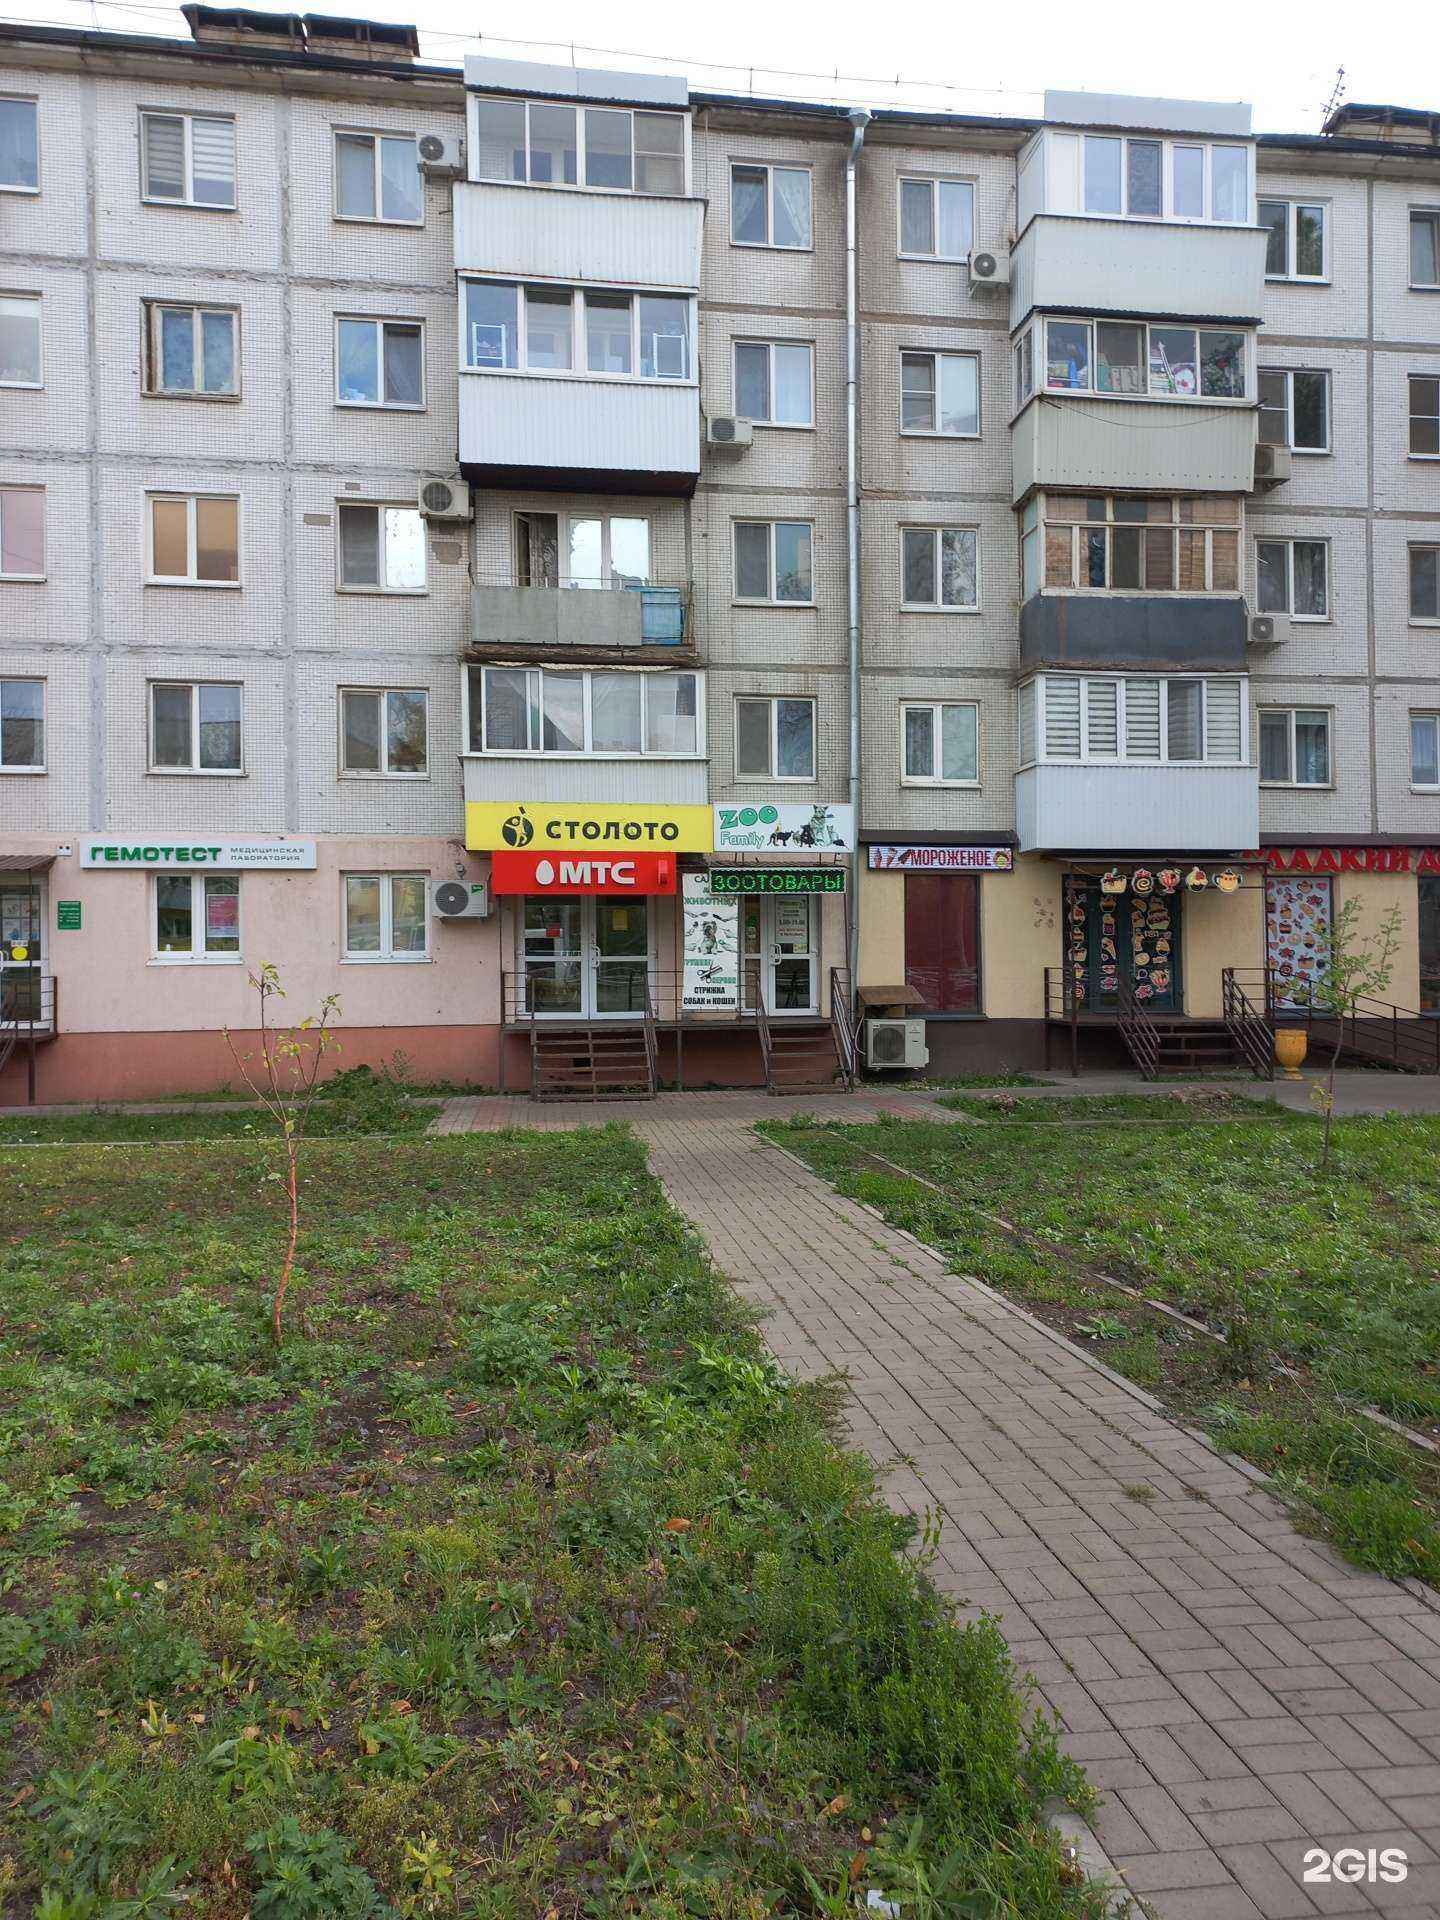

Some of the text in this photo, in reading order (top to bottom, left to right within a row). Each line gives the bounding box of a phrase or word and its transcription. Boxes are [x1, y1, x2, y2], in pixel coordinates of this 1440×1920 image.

[719, 805, 778, 830] ZOO
[546, 820, 679, 840] СТОЛОТО
[720, 830, 765, 849] Family
[91, 846, 222, 862] ГЕМОТЕСТ
[911, 849, 992, 866] МОРОЖЕНОЕ
[559, 861, 635, 885] МТС
[714, 875, 842, 890] ЗООТОВАРЫ
[694, 986, 726, 994] СТРИЖКА
[683, 997, 706, 1005] СОБАК
[712, 997, 736, 1005] КОШЕК
